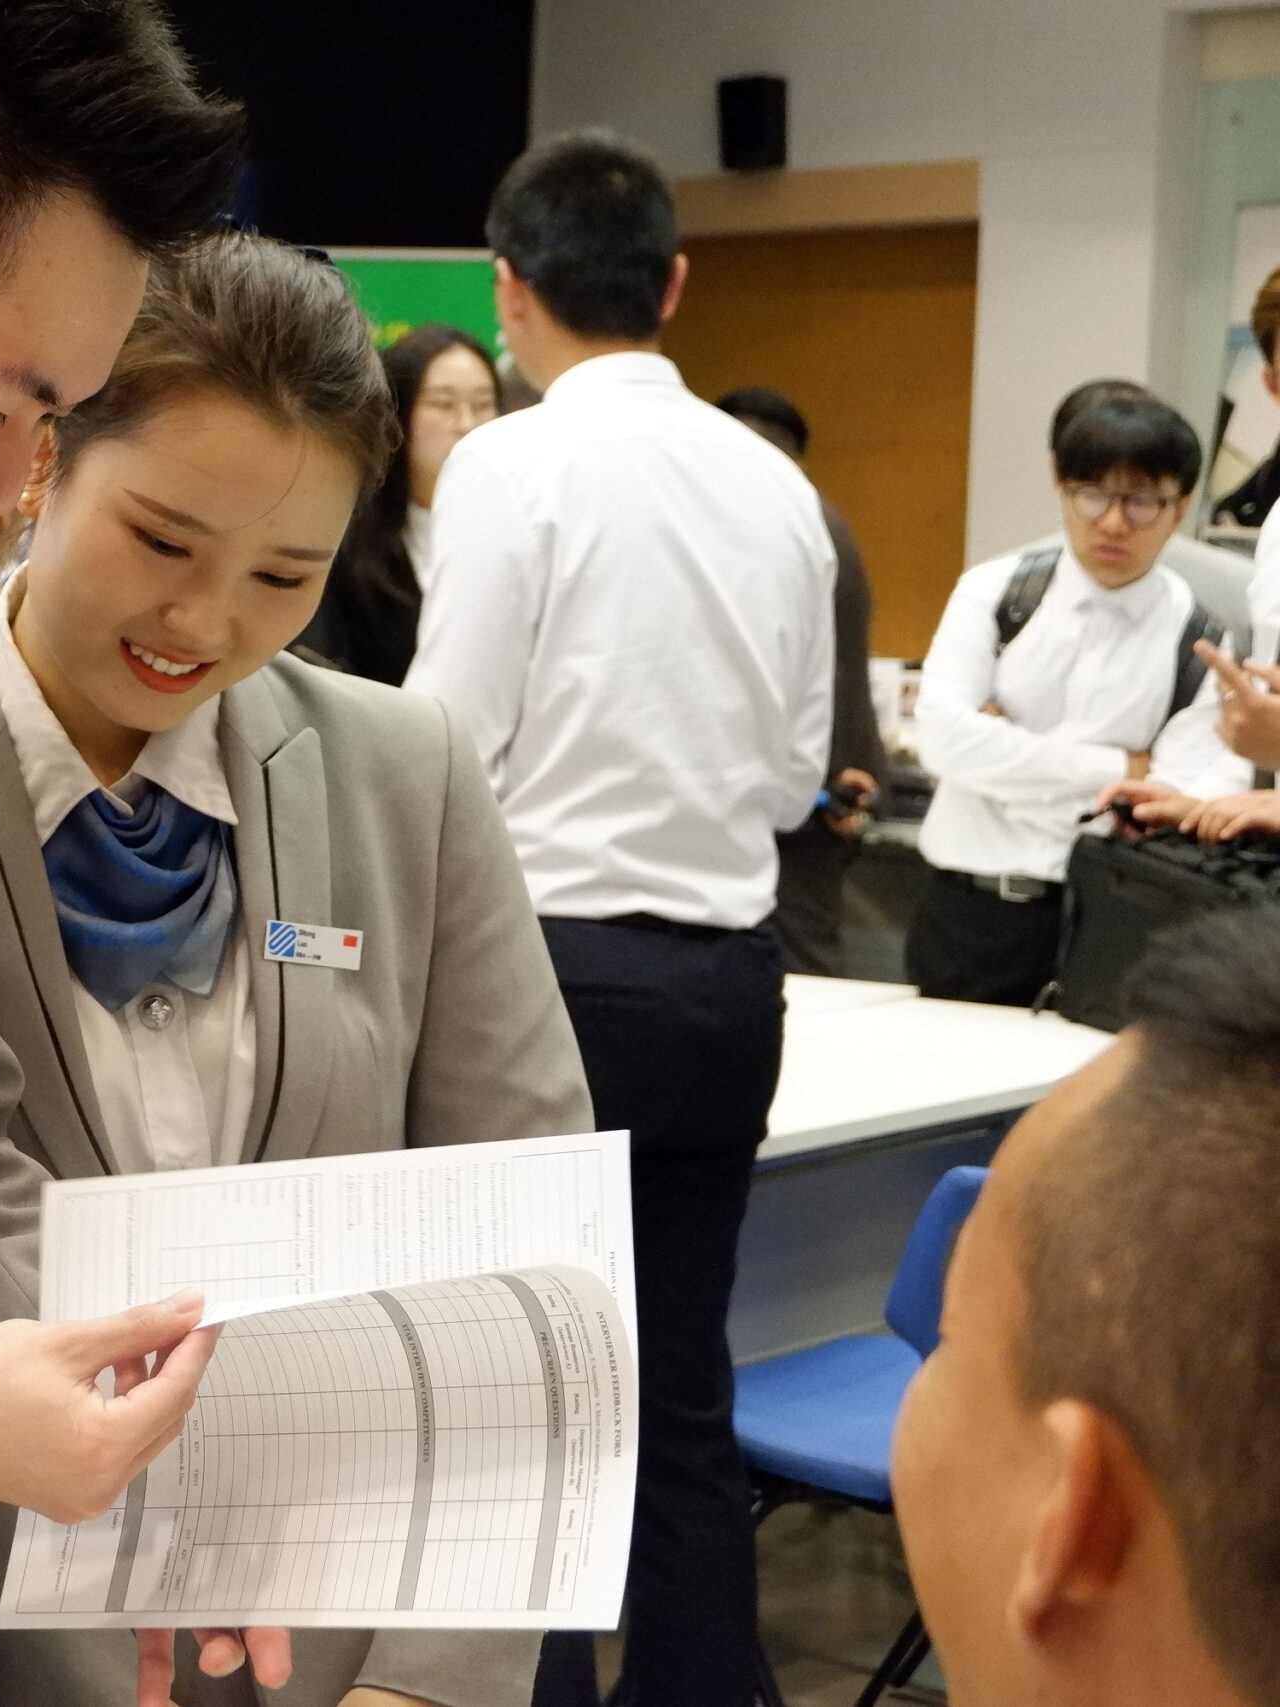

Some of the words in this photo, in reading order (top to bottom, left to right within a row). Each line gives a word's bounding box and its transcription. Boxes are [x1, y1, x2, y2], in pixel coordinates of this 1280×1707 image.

[563, 1322, 577, 1343] Human
[596, 1311, 617, 1372] INTERVIEWER
[569, 1344, 580, 1374] Resources
[402, 1323, 413, 1342] STAR
[408, 1343, 426, 1389] INTERVIEW
[420, 1391, 431, 1463] COMPETENCIES
[538, 1331, 558, 1384] PRE-SCREEN
[550, 1385, 561, 1440] QUESTIONS
[611, 1374, 622, 1426] FEEDBACK
[572, 1393, 581, 1415] Rating
[177, 1437, 185, 1464] Signature
[576, 1429, 586, 1466] Department
[614, 1429, 622, 1458] FORM
[576, 1467, 585, 1496] Manager
